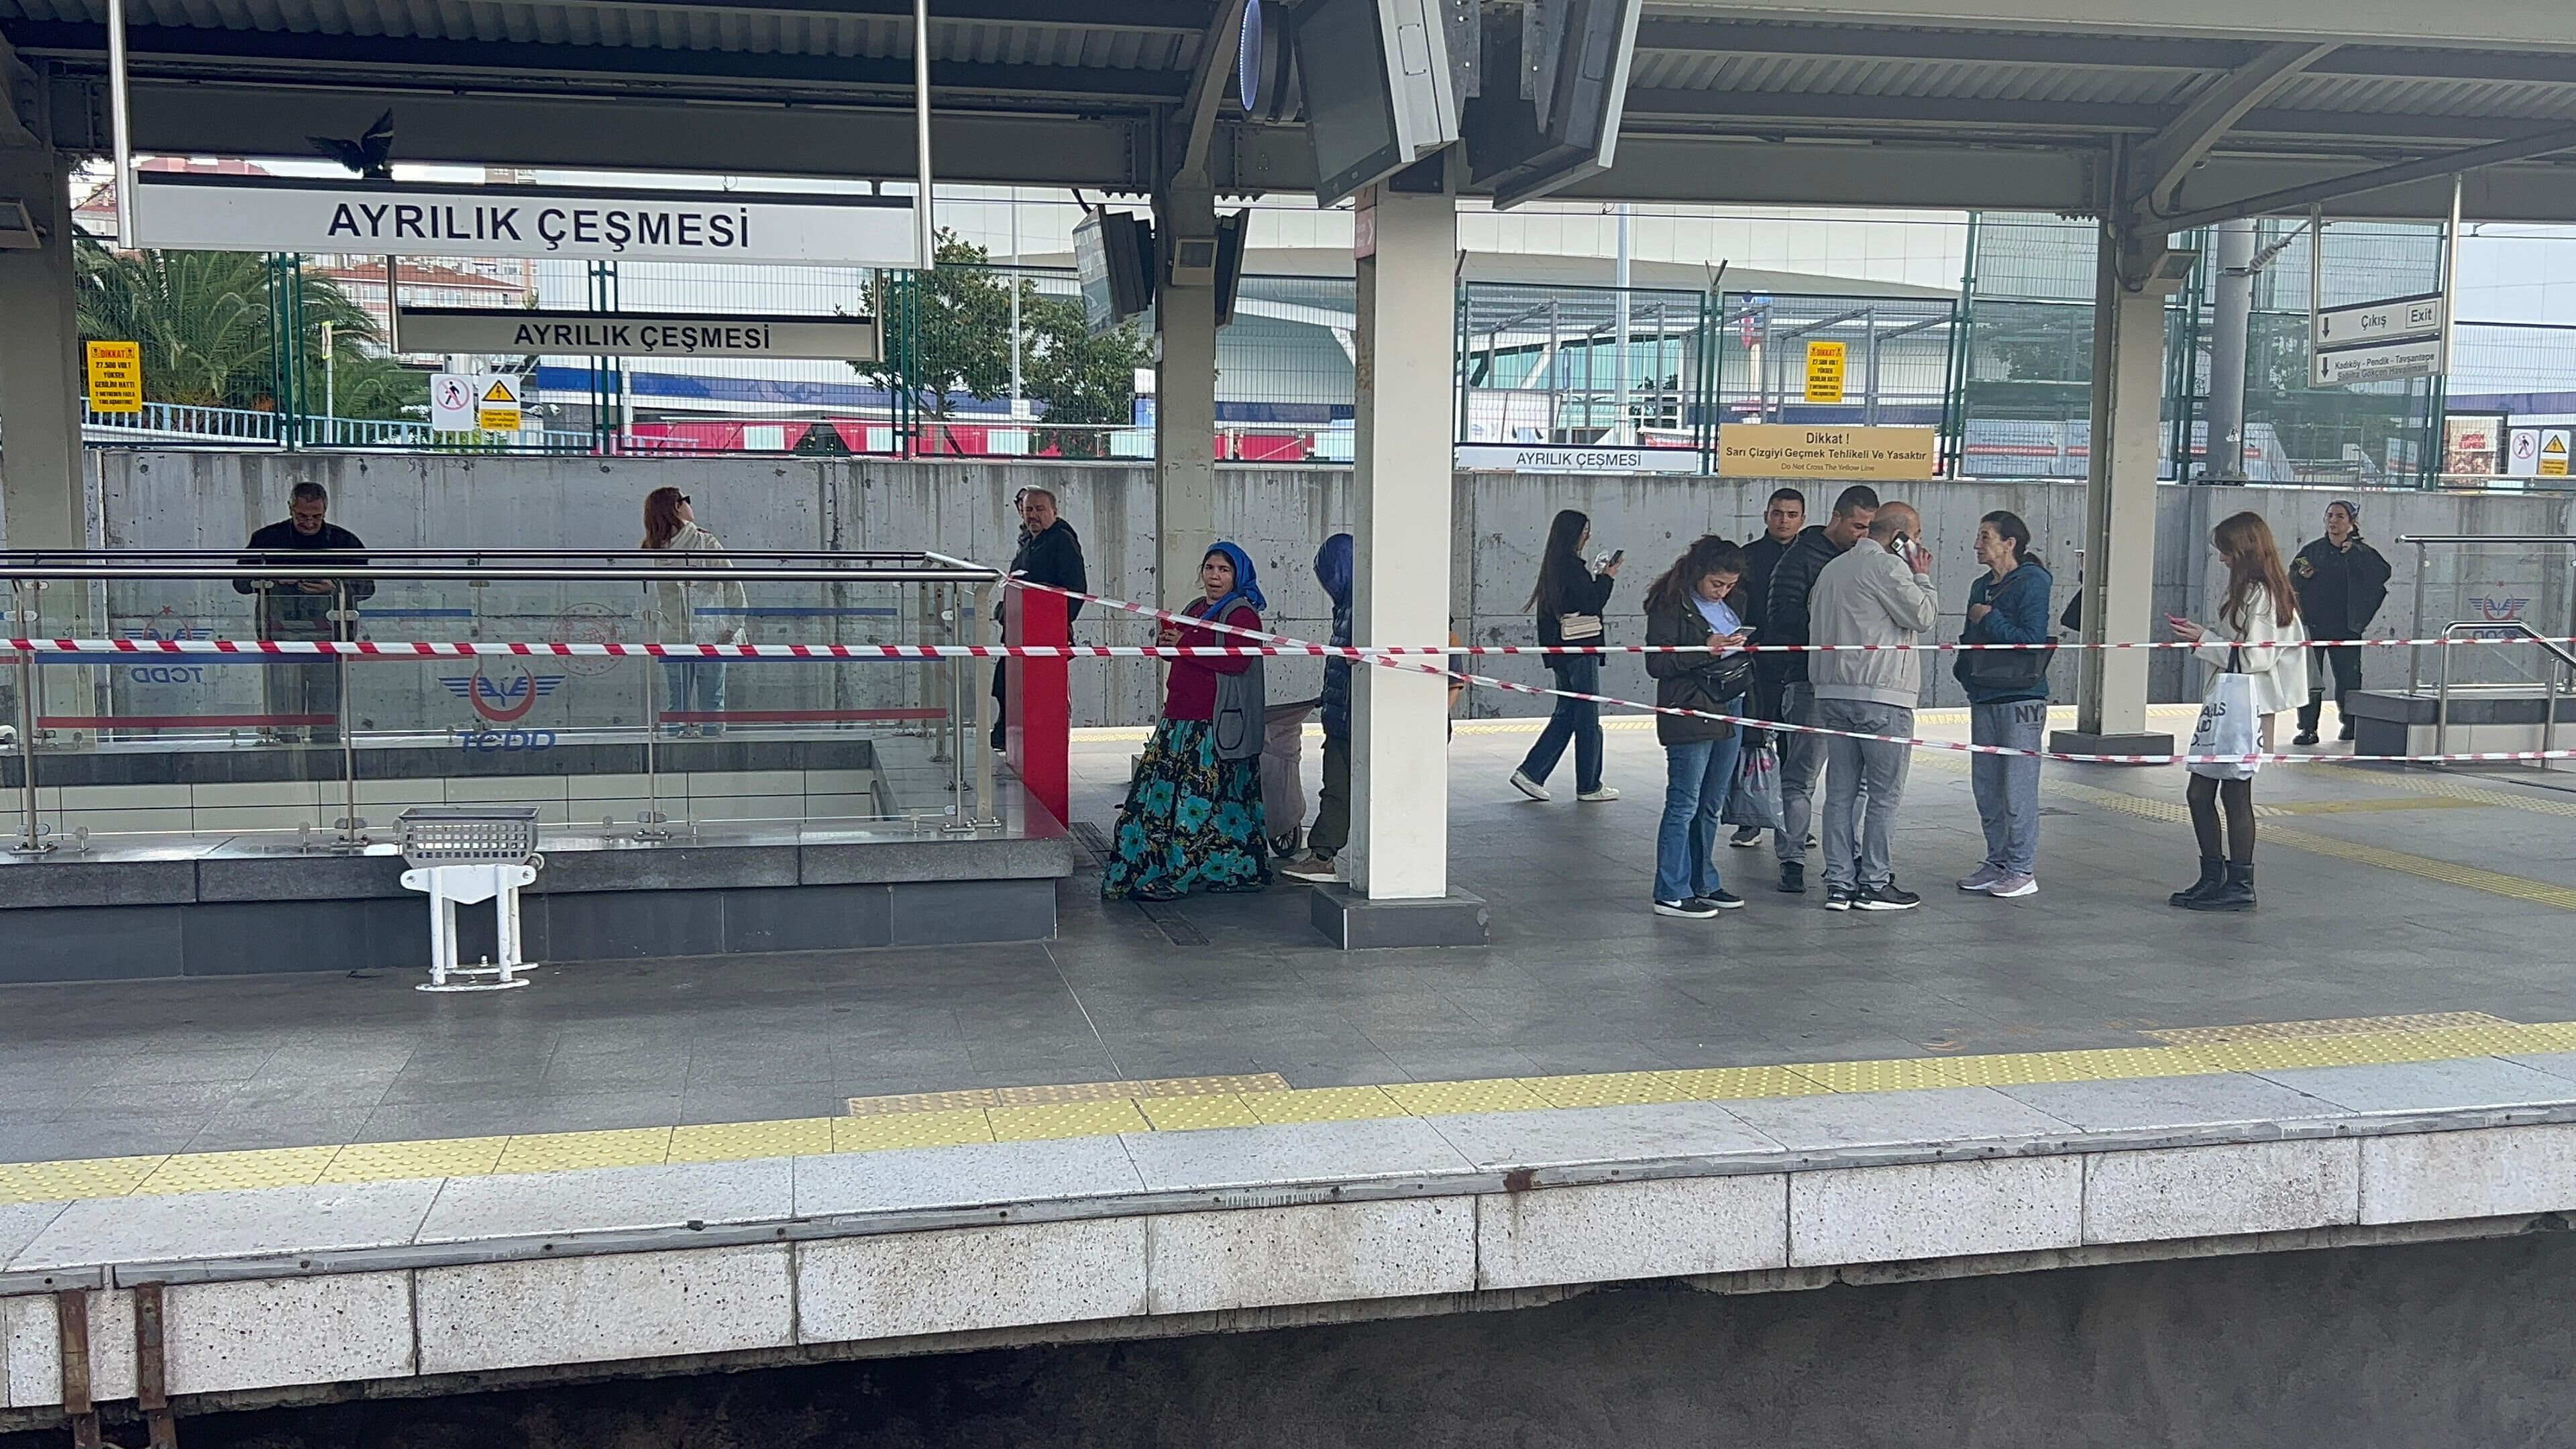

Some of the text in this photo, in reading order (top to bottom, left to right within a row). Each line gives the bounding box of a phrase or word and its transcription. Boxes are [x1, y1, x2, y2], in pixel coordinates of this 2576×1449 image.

[327, 203, 749, 252] AYRILIK ÇEŞMESİ
[2361, 313, 2387, 331] Çıkış
[2410, 308, 2432, 323] Exit
[514, 323, 770, 353] AYRILIK ÇEŞMESİ
[101, 350, 125, 358] DİKKAT
[2367, 357, 2390, 367] Pendik
[1806, 433, 1850, 445] Dikkat !
[1516, 451, 1642, 469] AYRILIK ÇEŞMESİ
[1726, 447, 1927, 460] Sarı Çizgiyi Geçmek Tehlikeli Ve Yasaktır
[456, 729, 556, 753] TCDD
